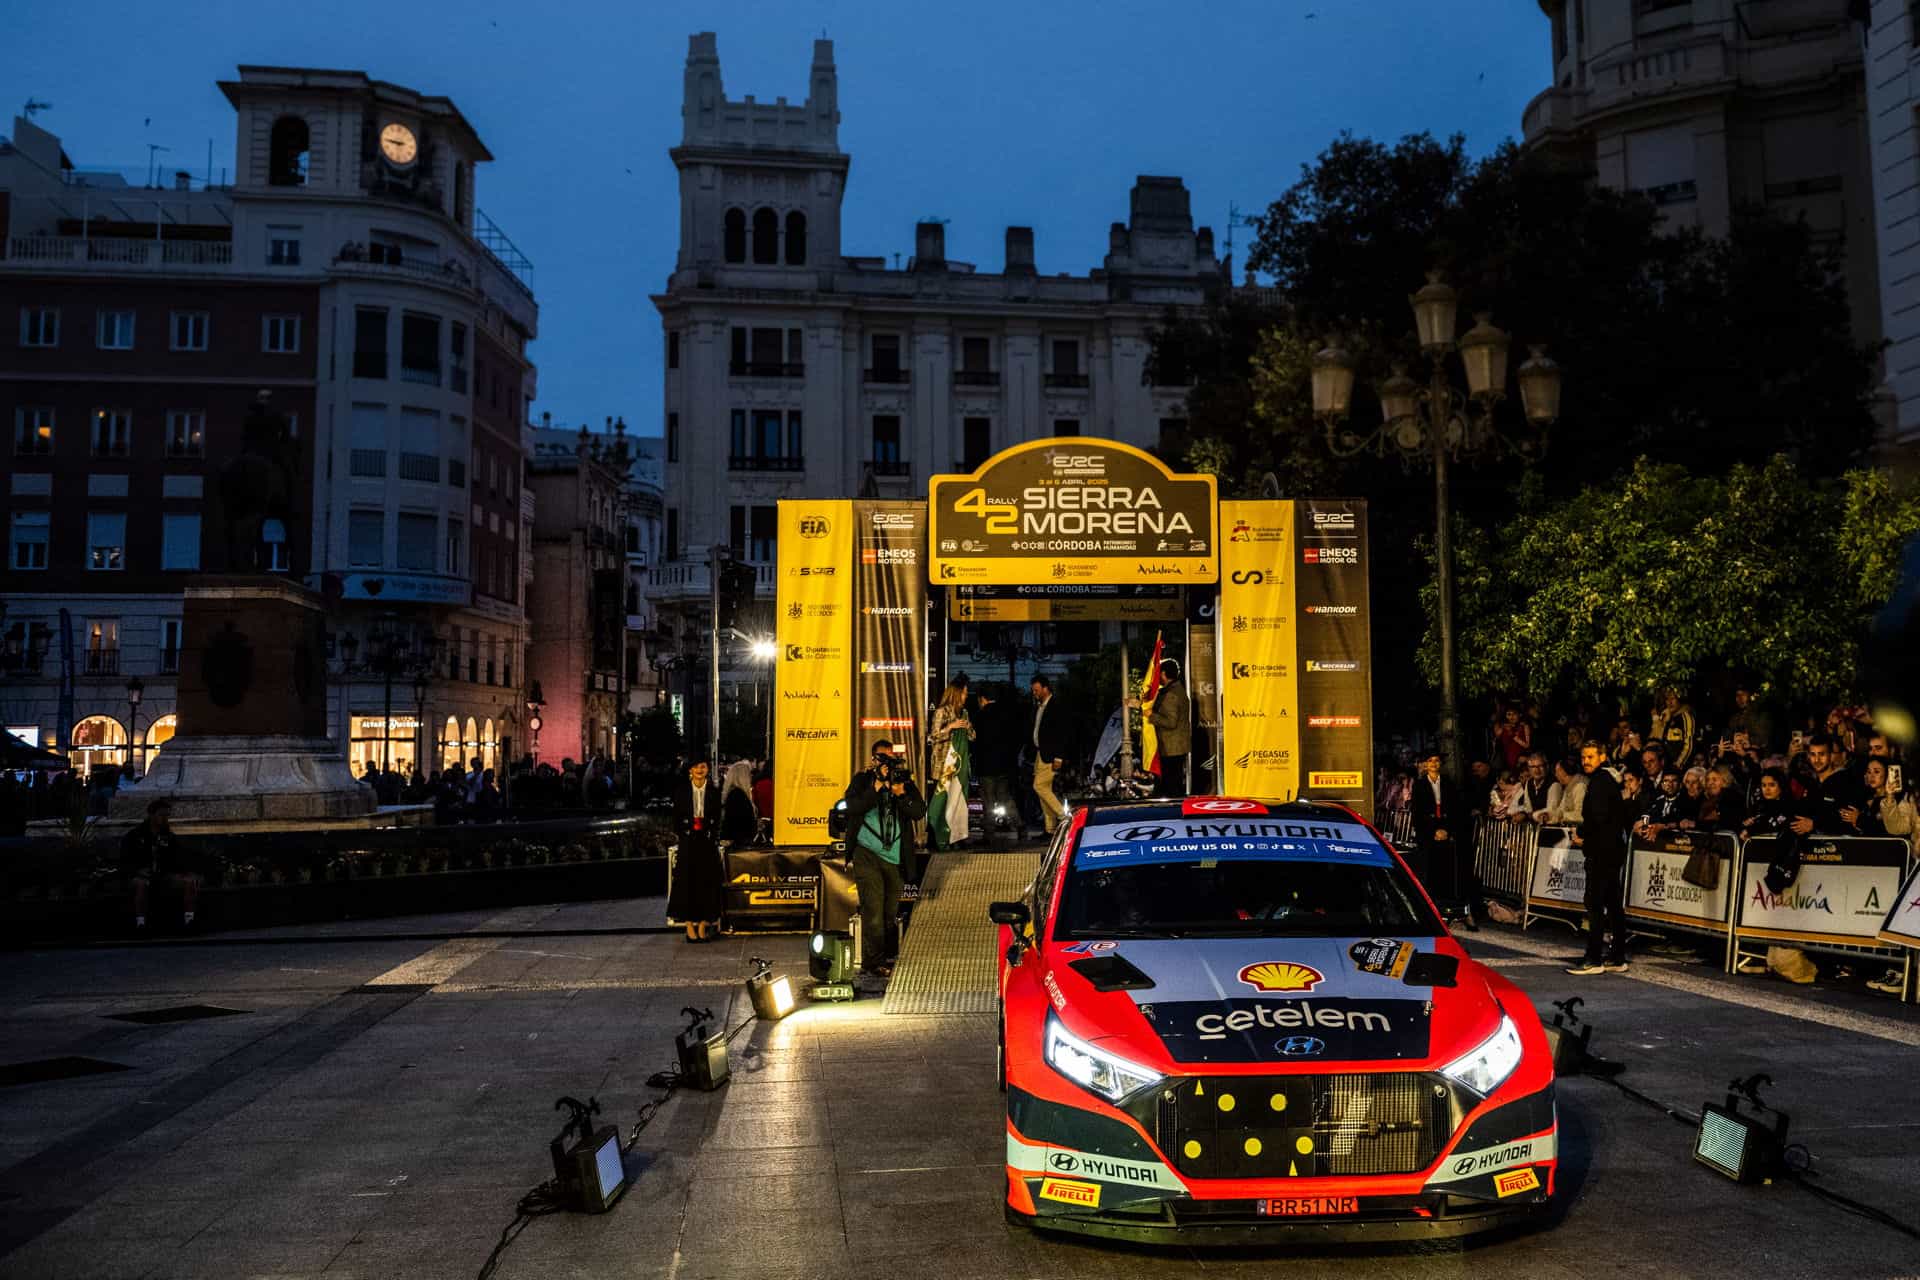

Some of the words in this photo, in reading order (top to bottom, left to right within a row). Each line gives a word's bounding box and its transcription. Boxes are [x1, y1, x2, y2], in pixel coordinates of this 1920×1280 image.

[1023, 487, 1162, 510] SIERRA
[1023, 512, 1194, 534] MORENA
[878, 549, 916, 558] ENEOS
[1048, 539, 1102, 551] CÓRDOBA
[1320, 549, 1357, 557] ENEOS
[1253, 750, 1289, 758] PEGASUS
[1186, 825, 1343, 839] HYUNDAI
[1152, 844, 1199, 853] FOLLOW
[1202, 843, 1218, 851] US
[775, 889, 816, 898] MOR
[1196, 1001, 1391, 1036] cetelem
[1478, 1143, 1533, 1169] HYUNDAI
[1082, 1159, 1158, 1183] HYUNDAI
[1499, 1172, 1534, 1192] PIRELLI
[1047, 1182, 1095, 1202] PIRELLI
